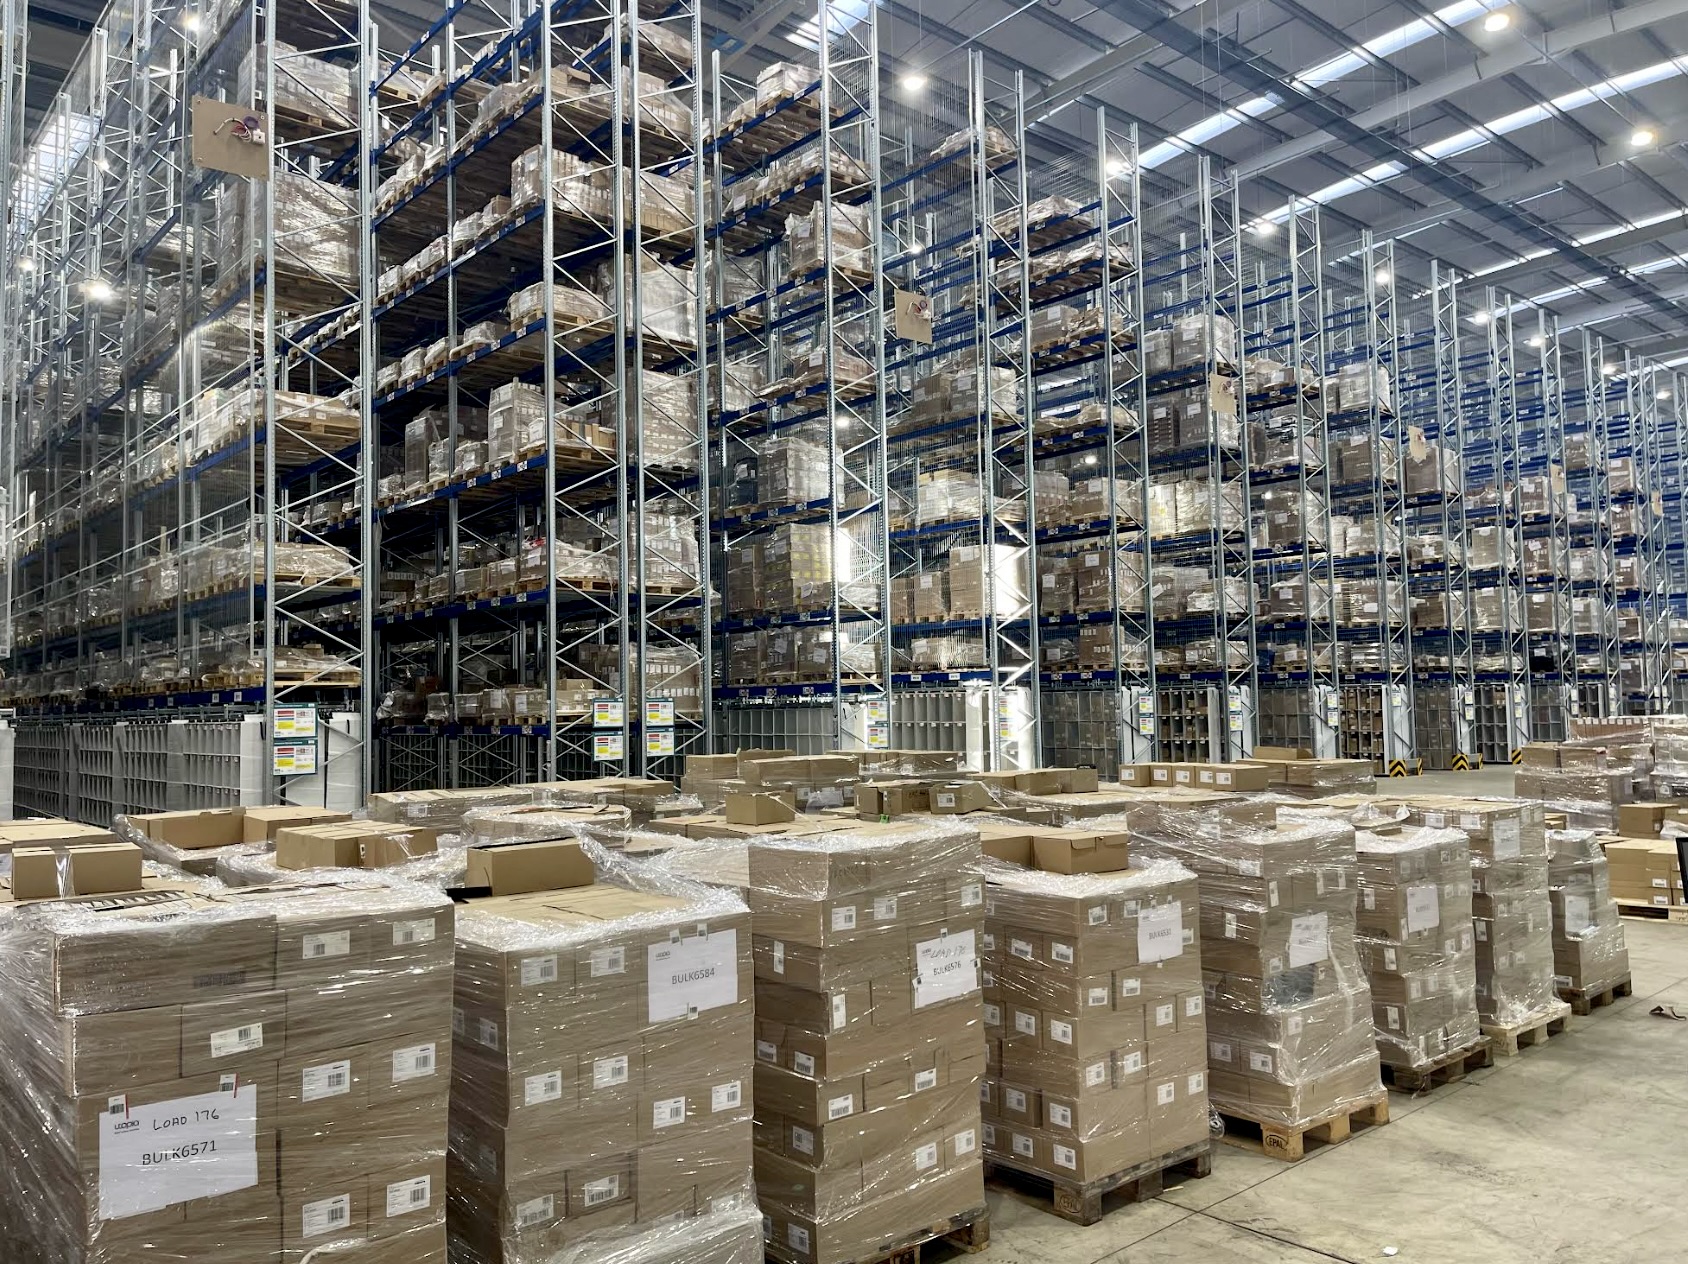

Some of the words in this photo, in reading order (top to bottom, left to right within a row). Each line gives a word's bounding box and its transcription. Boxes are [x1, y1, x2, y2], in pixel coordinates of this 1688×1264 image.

[671, 967, 715, 985] BULK6584
[933, 960, 962, 976] BULK6576
[114, 1119, 140, 1131] utopia
[153, 1116, 187, 1131] LOAD
[195, 1108, 220, 1122] 176
[142, 1140, 217, 1166] BULK6571
